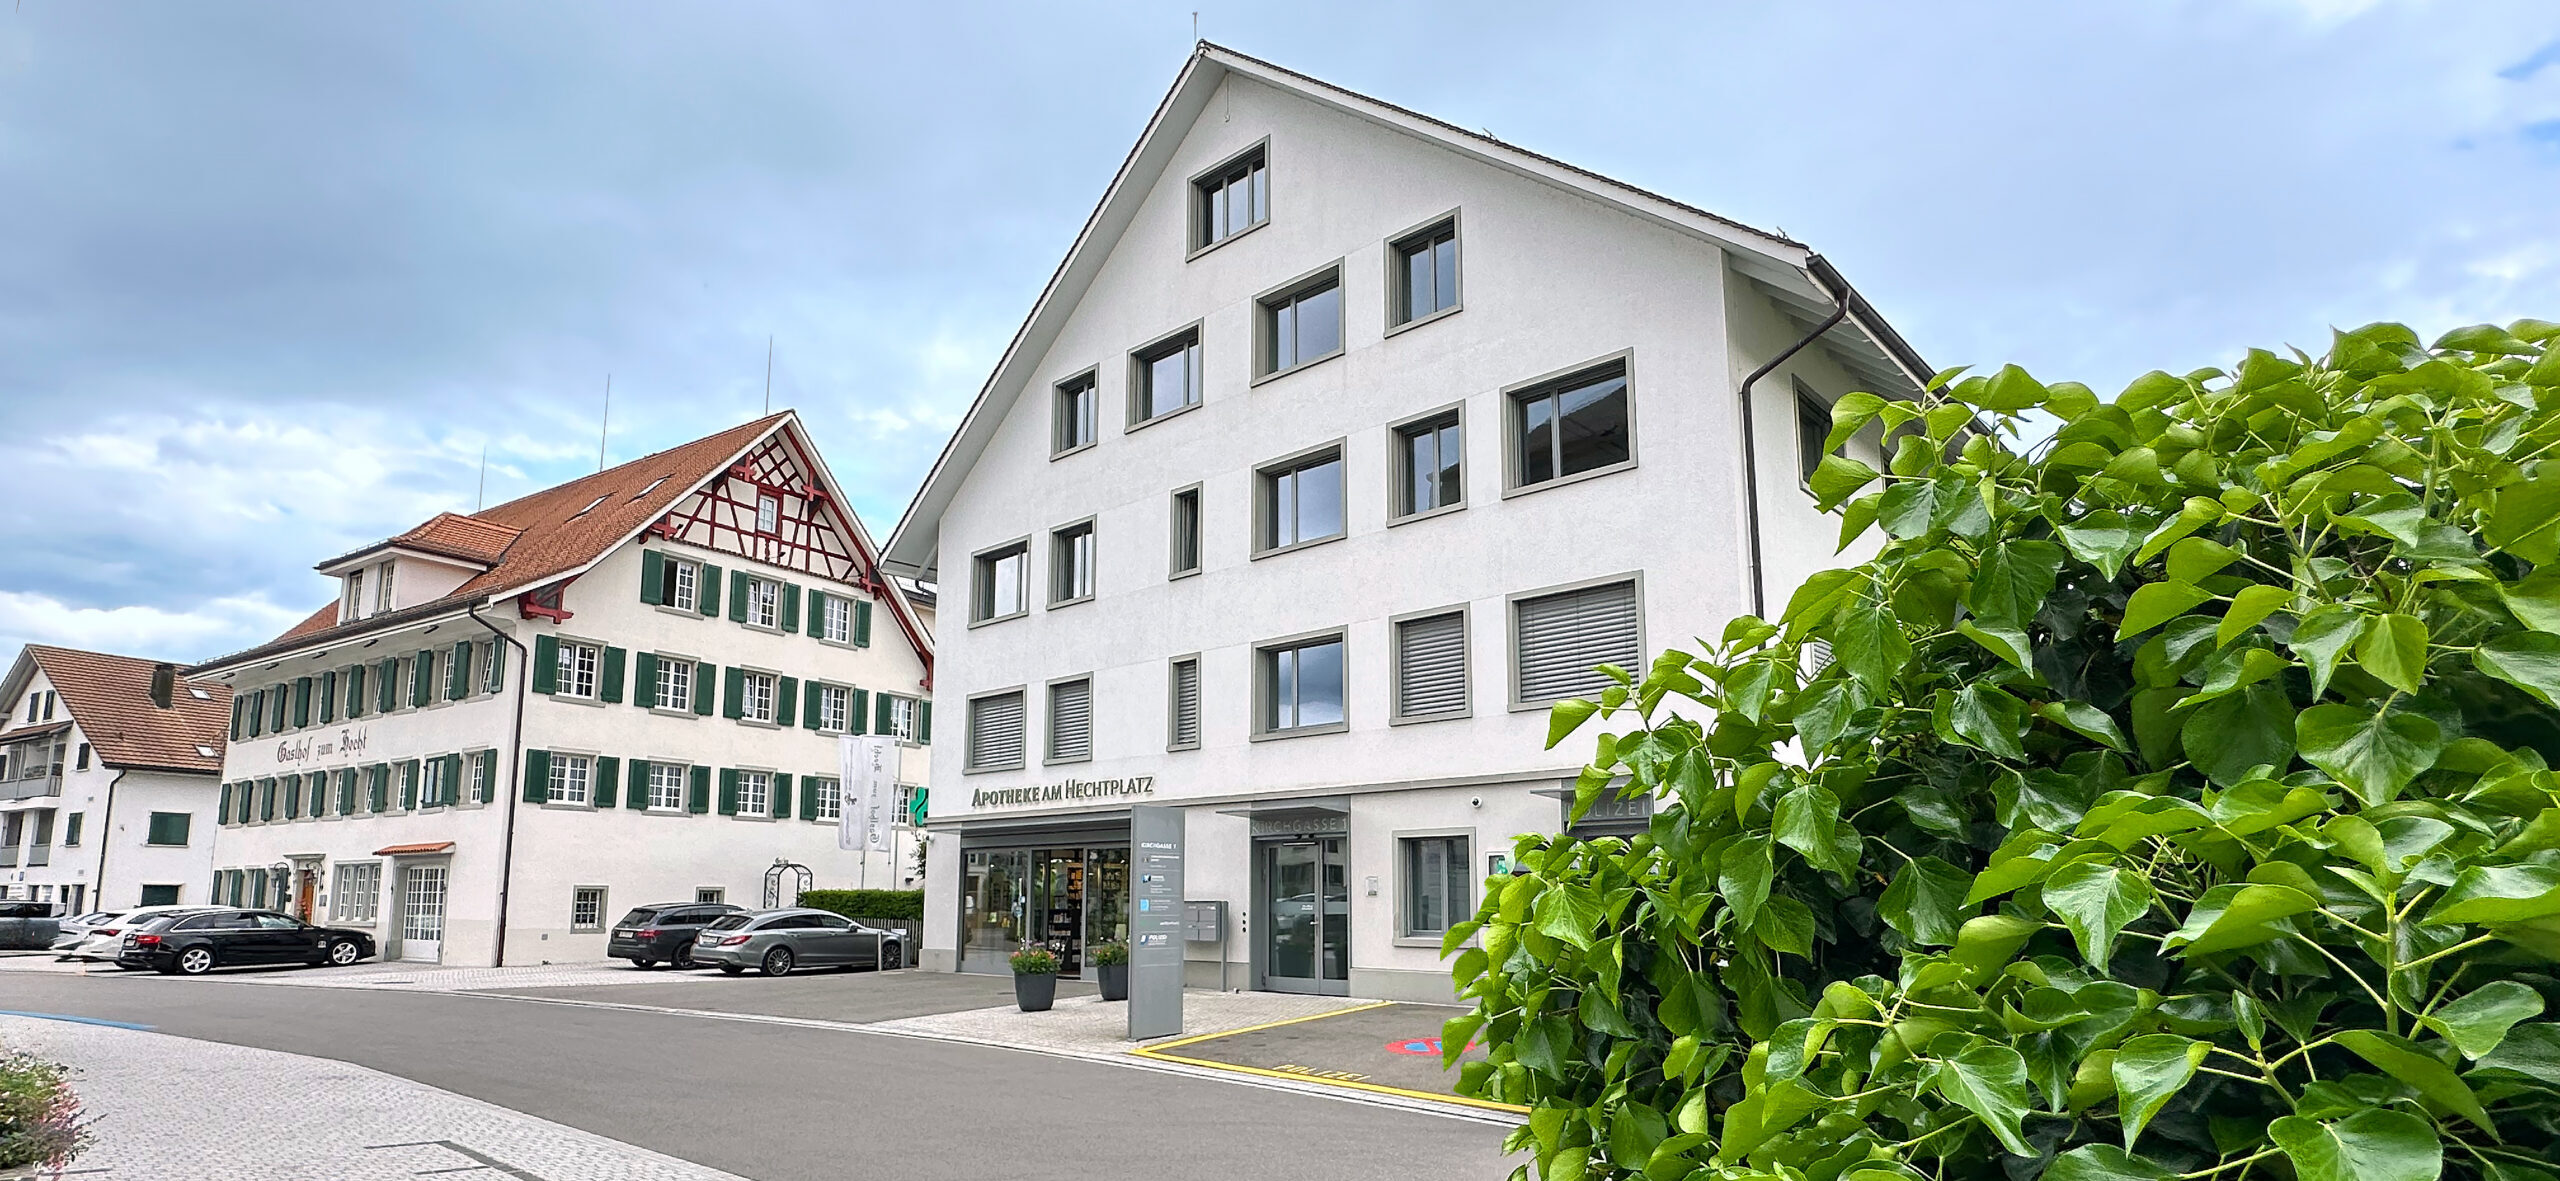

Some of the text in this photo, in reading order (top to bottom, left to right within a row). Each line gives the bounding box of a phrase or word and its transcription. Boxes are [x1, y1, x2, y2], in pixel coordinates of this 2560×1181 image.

[277, 725, 367, 767] Gasthof zum Hecht
[972, 776, 1154, 807] APOTHEKE AM HECHTPLATZ
[1566, 800, 1646, 818] LIZEI
[1251, 817, 1347, 834] KIRCHGASSE 1
[1272, 1064, 1371, 1081] POLIZEI
